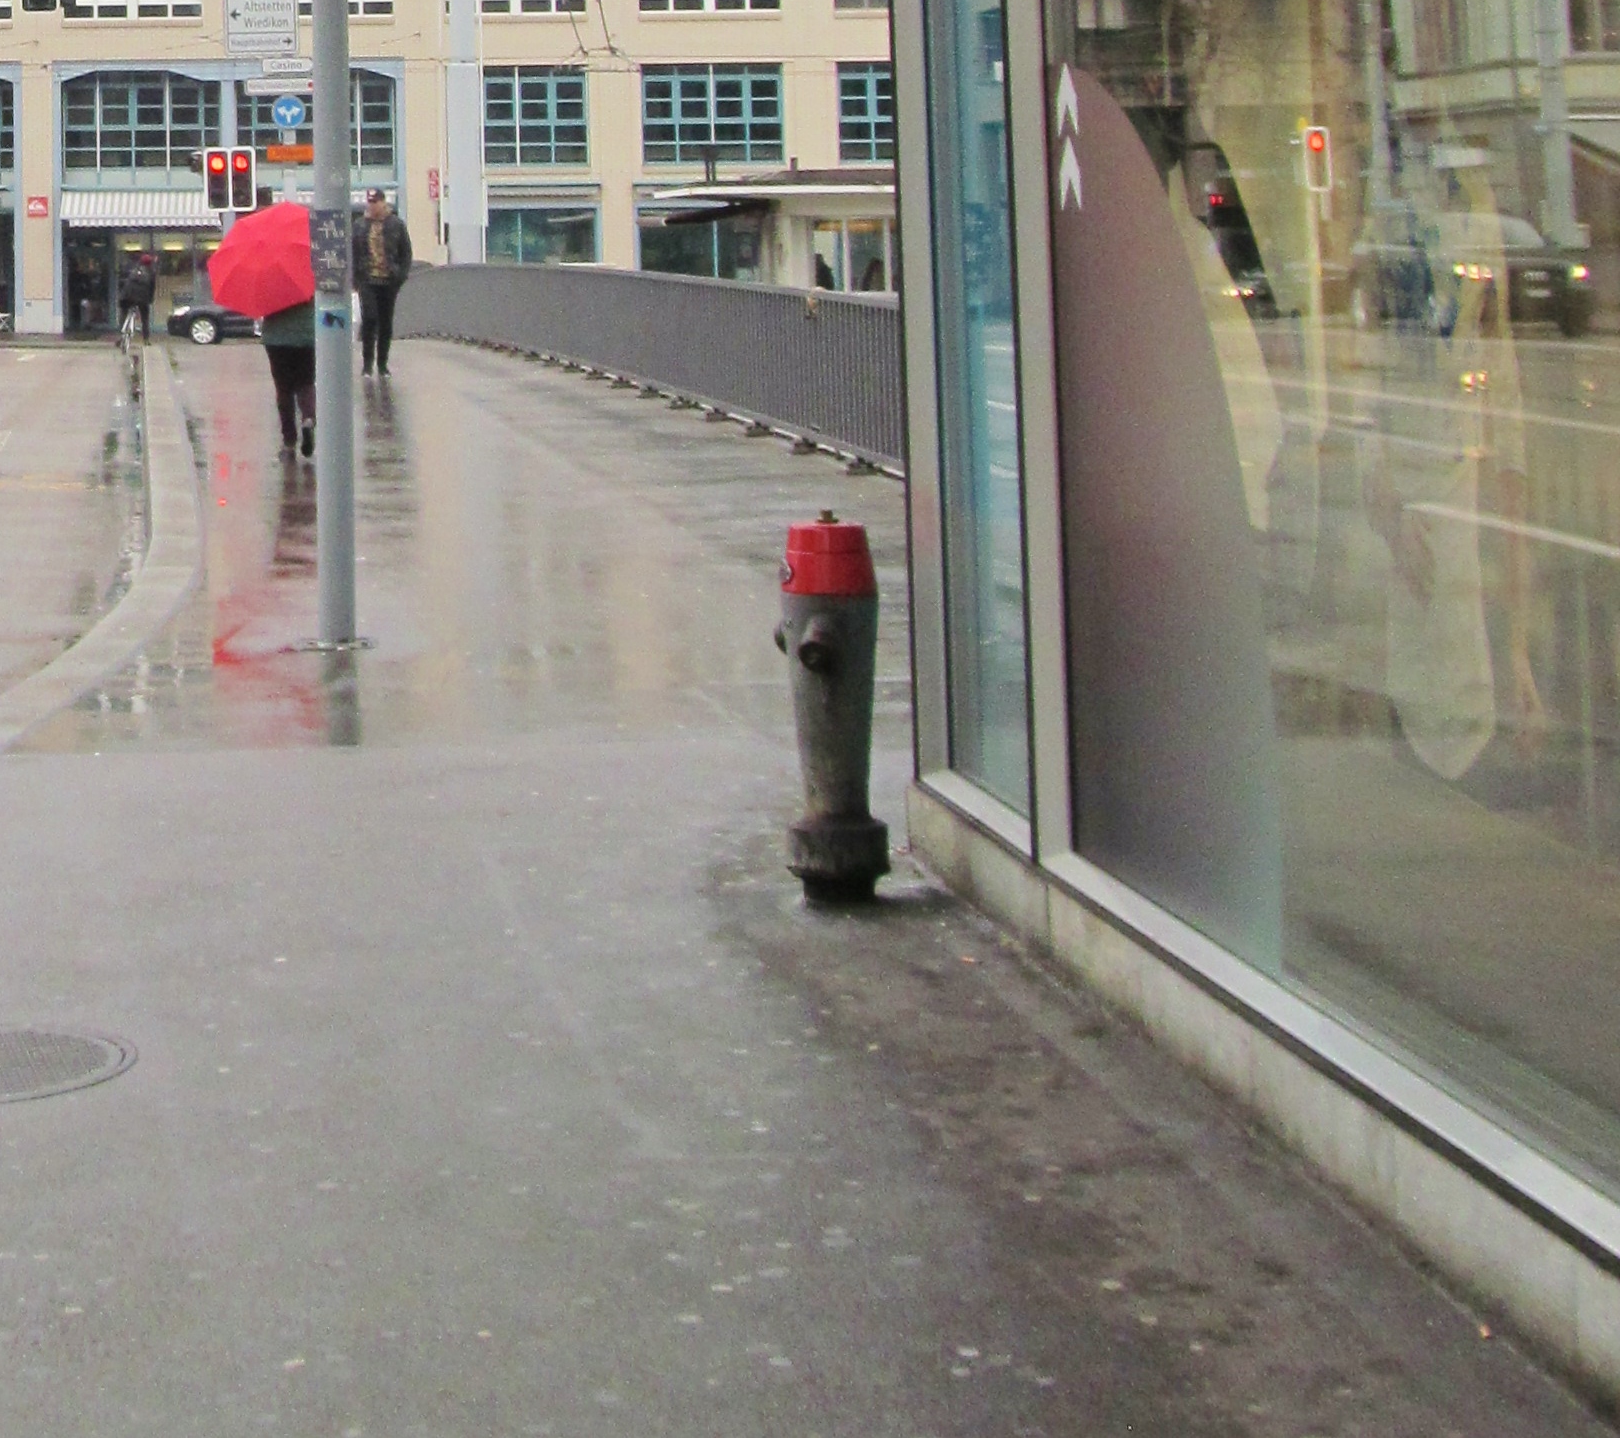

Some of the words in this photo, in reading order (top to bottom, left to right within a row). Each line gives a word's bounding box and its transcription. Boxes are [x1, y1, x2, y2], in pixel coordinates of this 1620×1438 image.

[243, 0, 292, 12] Altstetten
[243, 16, 290, 28] Wiedikon
[270, 61, 303, 70] Casino
